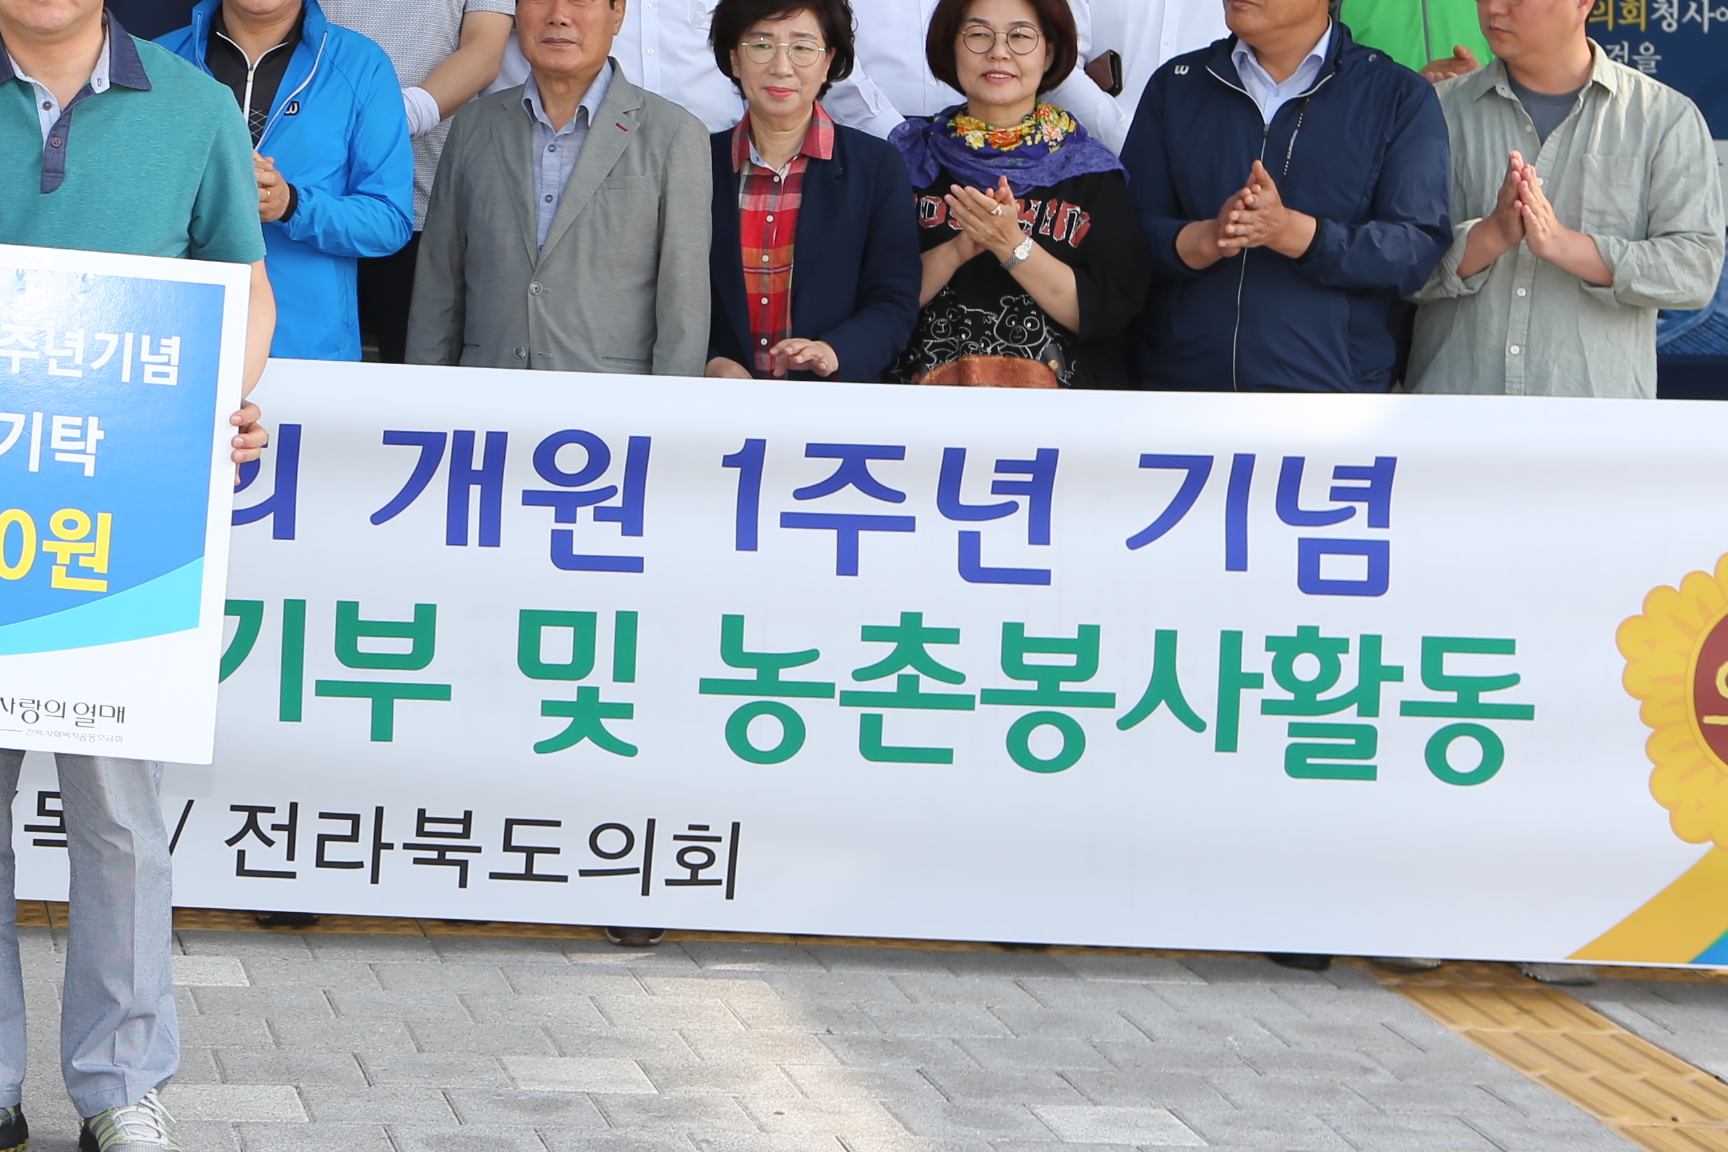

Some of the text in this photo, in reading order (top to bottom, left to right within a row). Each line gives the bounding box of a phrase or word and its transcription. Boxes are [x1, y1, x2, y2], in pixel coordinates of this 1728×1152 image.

[369, 428, 654, 575] 개원
[720, 436, 1061, 587] 1주년
[1124, 452, 1398, 598] 기념
[72, 702, 126, 729] 열매
[217, 598, 452, 743] 기부
[516, 608, 640, 759] 및
[698, 610, 1536, 787] 농촌봉사활동
[223, 802, 743, 900] 전라북도의회
